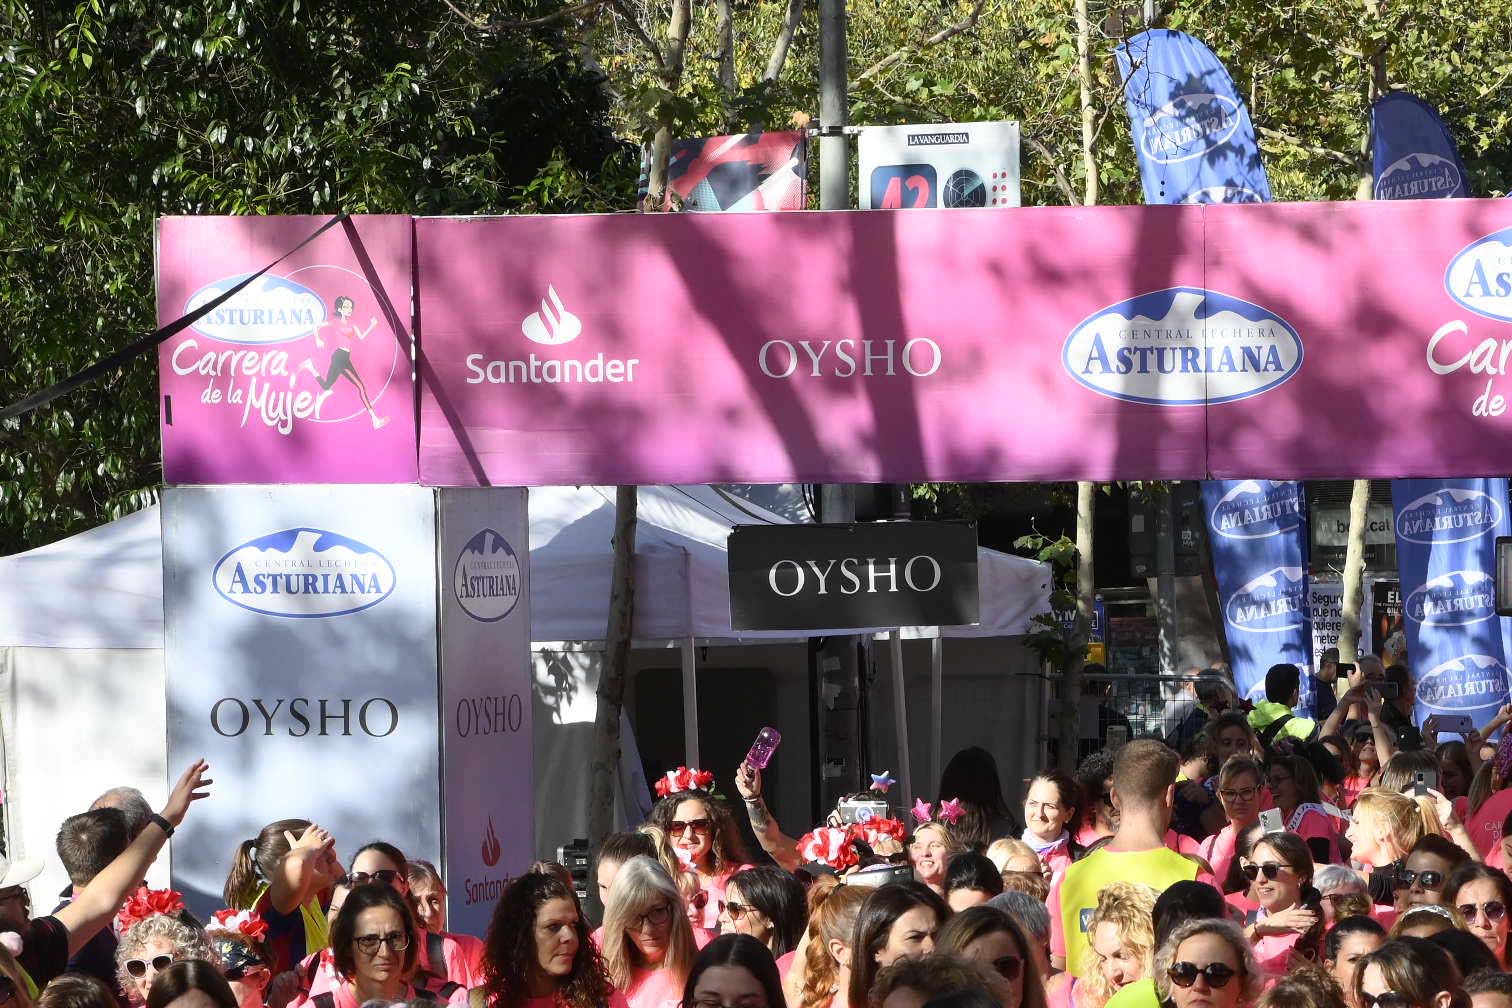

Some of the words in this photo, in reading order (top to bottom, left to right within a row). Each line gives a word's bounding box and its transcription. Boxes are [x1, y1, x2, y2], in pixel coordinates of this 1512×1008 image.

[1118, 328, 1193, 340] CENTRAL
[171, 338, 289, 376] Carrera
[466, 352, 640, 384] Santander
[758, 337, 943, 379] OYSHO
[1082, 333, 1286, 377] ASTURIANA
[201, 376, 222, 404] de
[227, 378, 243, 404] la
[240, 376, 333, 435] Mujer
[1472, 378, 1506, 417] de
[228, 561, 383, 595] ASTURIANA
[254, 559, 313, 568] CENTRAL
[459, 564, 518, 598] ASTURIANA
[769, 556, 943, 598] OYSHO
[210, 697, 399, 739] OYSHO
[457, 693, 523, 739] OYSHO
[464, 872, 512, 906] Santan
